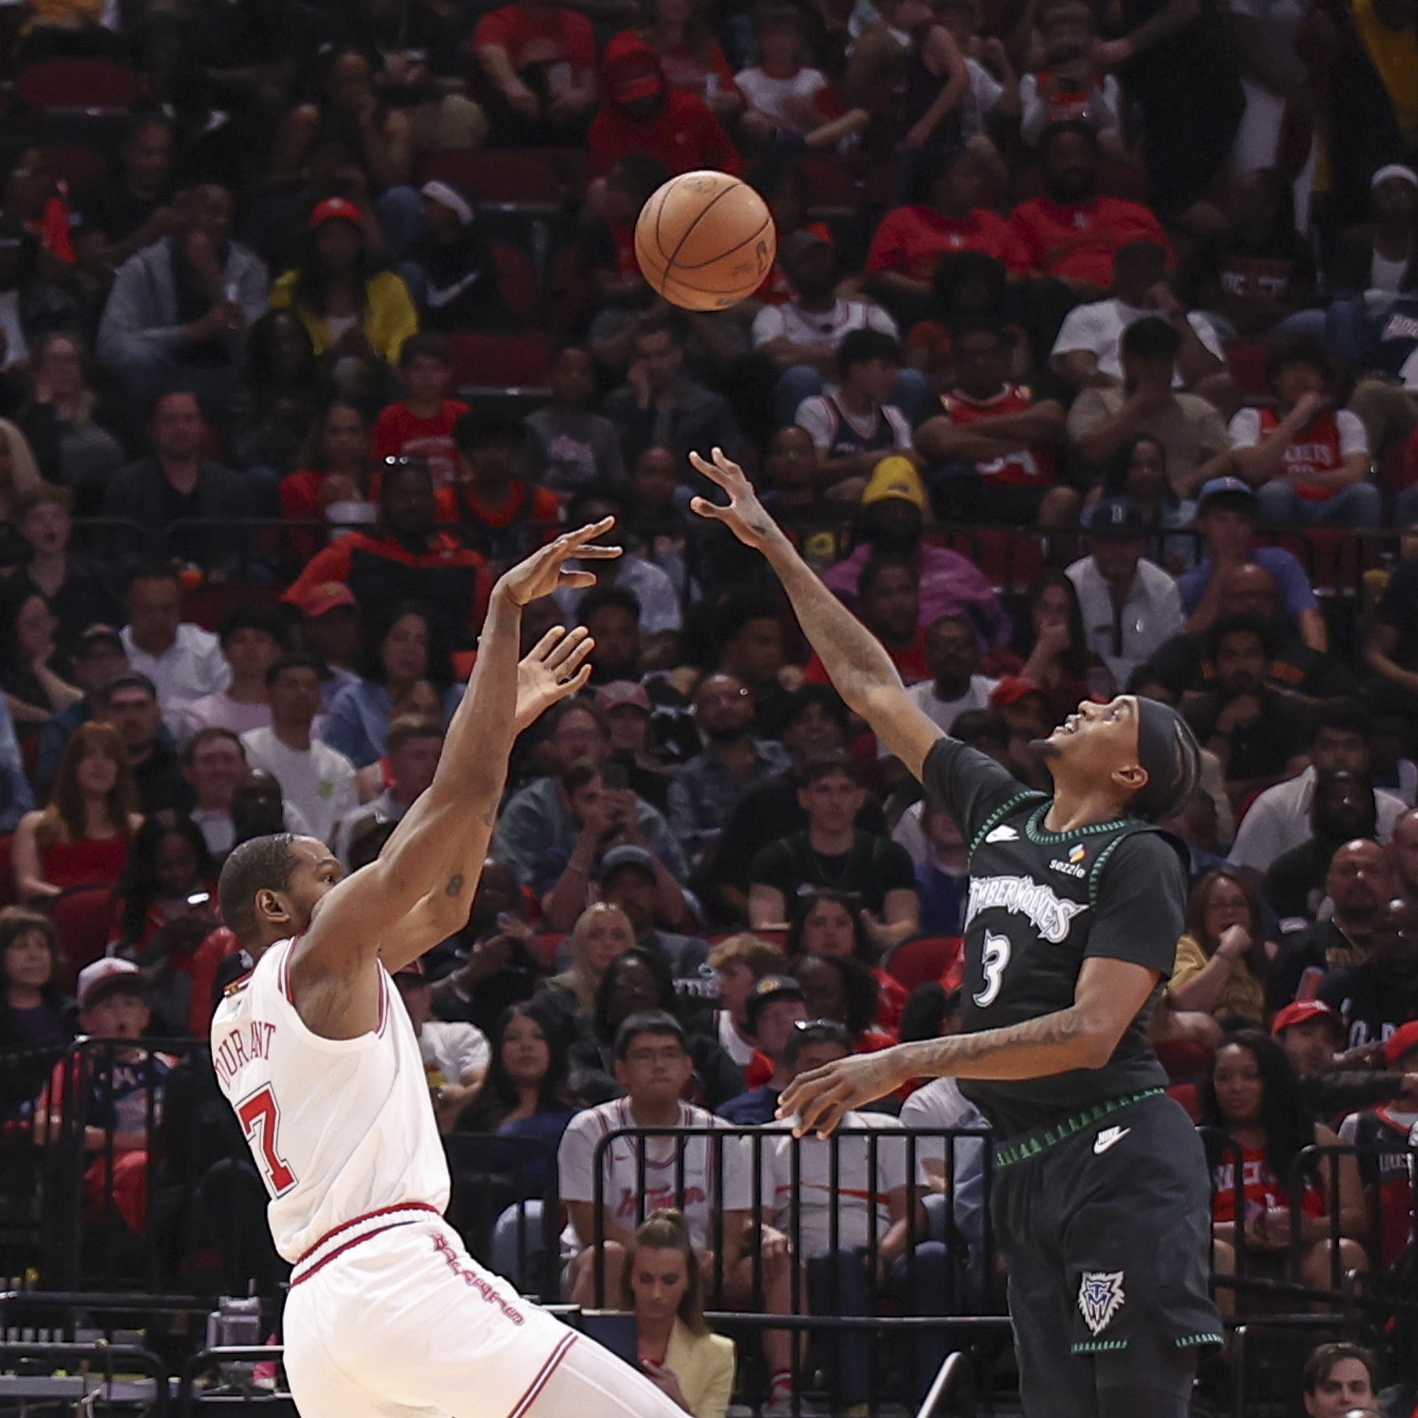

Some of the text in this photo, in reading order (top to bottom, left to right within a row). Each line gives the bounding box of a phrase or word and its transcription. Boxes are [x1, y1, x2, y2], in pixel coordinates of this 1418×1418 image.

[1049, 859, 1086, 879] sezzle
[972, 928, 1011, 1007] 3
[213, 1020, 276, 1091] DURANT
[234, 1081, 299, 1200] 7
